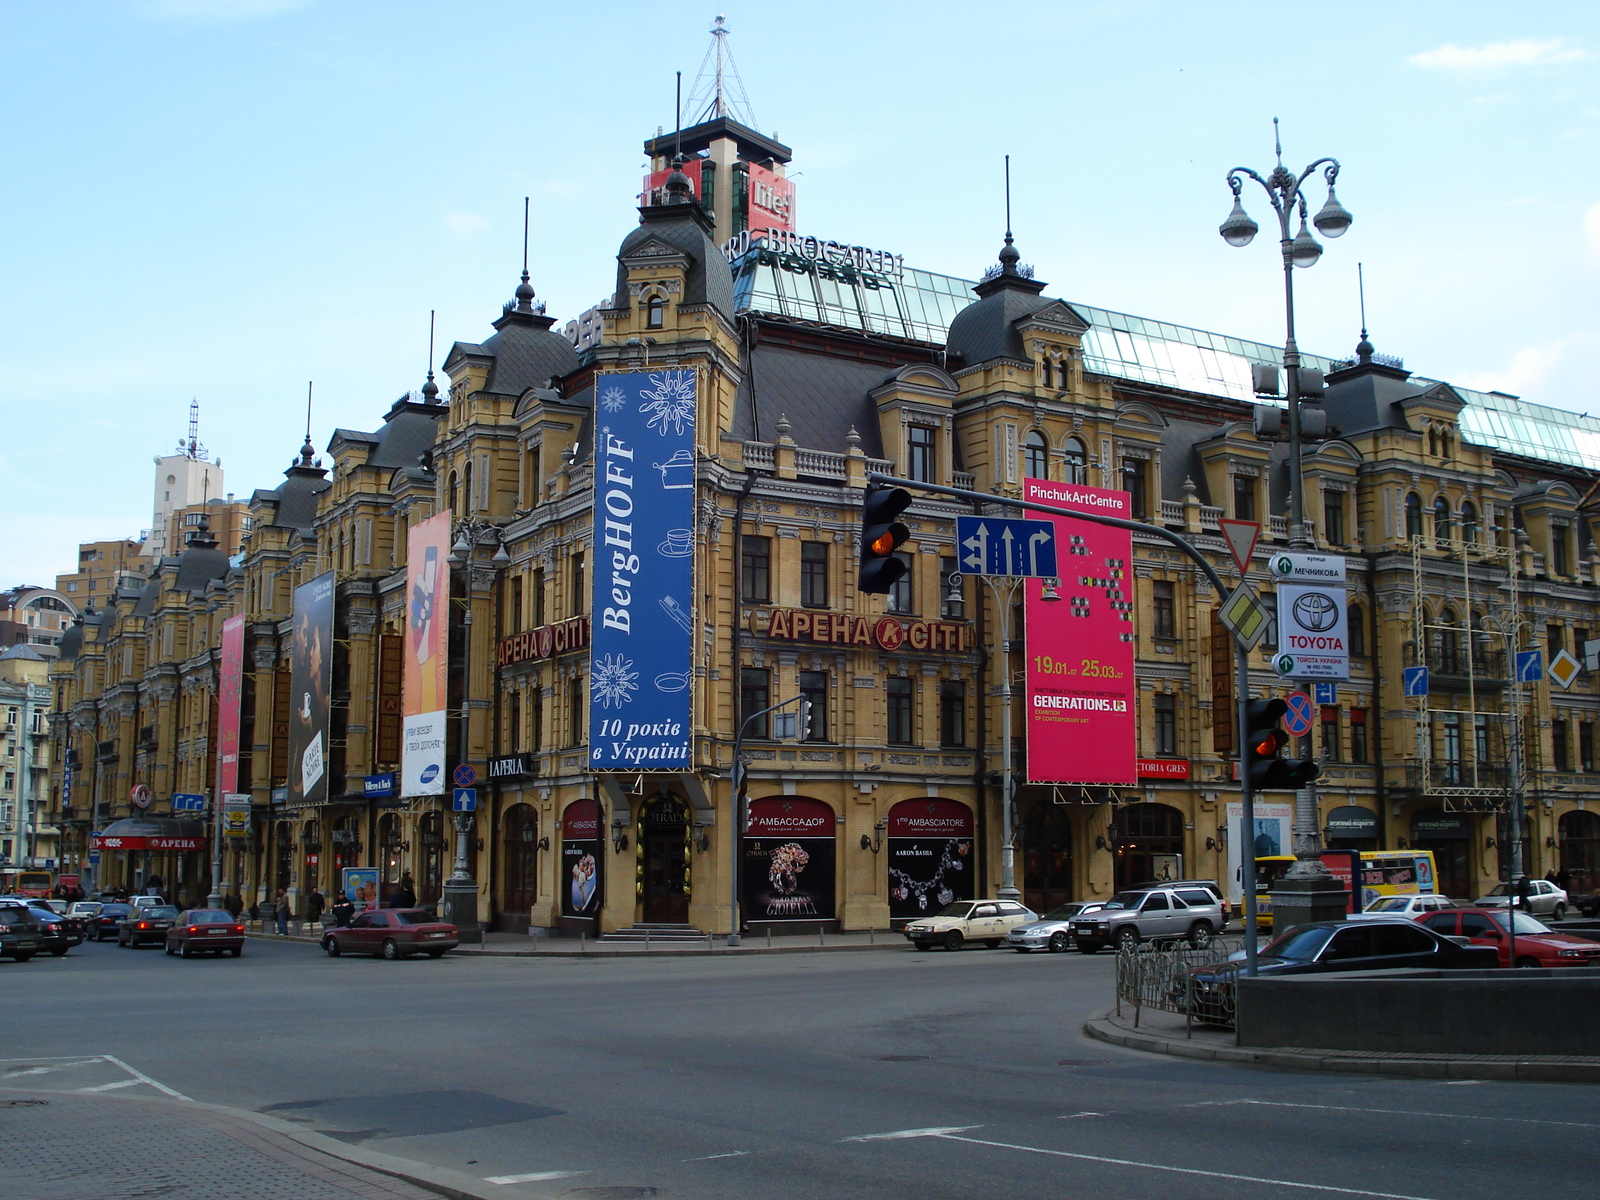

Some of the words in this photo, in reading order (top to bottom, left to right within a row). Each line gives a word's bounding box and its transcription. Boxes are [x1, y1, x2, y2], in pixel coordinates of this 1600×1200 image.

[766, 227, 897, 275] BROCARD
[1030, 485, 1123, 509] PinchukArtCentre
[603, 433, 639, 635] BergHOFF
[1294, 567, 1339, 577] МЕЧНИКОВА
[768, 611, 871, 645] АРЕНА
[498, 632, 538, 665] АРЕНА
[1288, 636, 1343, 650] TOYOTA
[599, 719, 622, 736] 10
[625, 718, 681, 741] років
[305, 742, 320, 767] CARTE
[592, 747, 603, 760] в
[611, 741, 688, 764] Україні
[306, 756, 320, 780] NOIRE
[1166, 764, 1186, 773] GRES
[759, 818, 825, 826] АМБАССАДОР
[908, 819, 965, 827] AMBASCIATORE
[160, 839, 196, 848] АРЕНА
[766, 902, 818, 916] GIOIELLI
